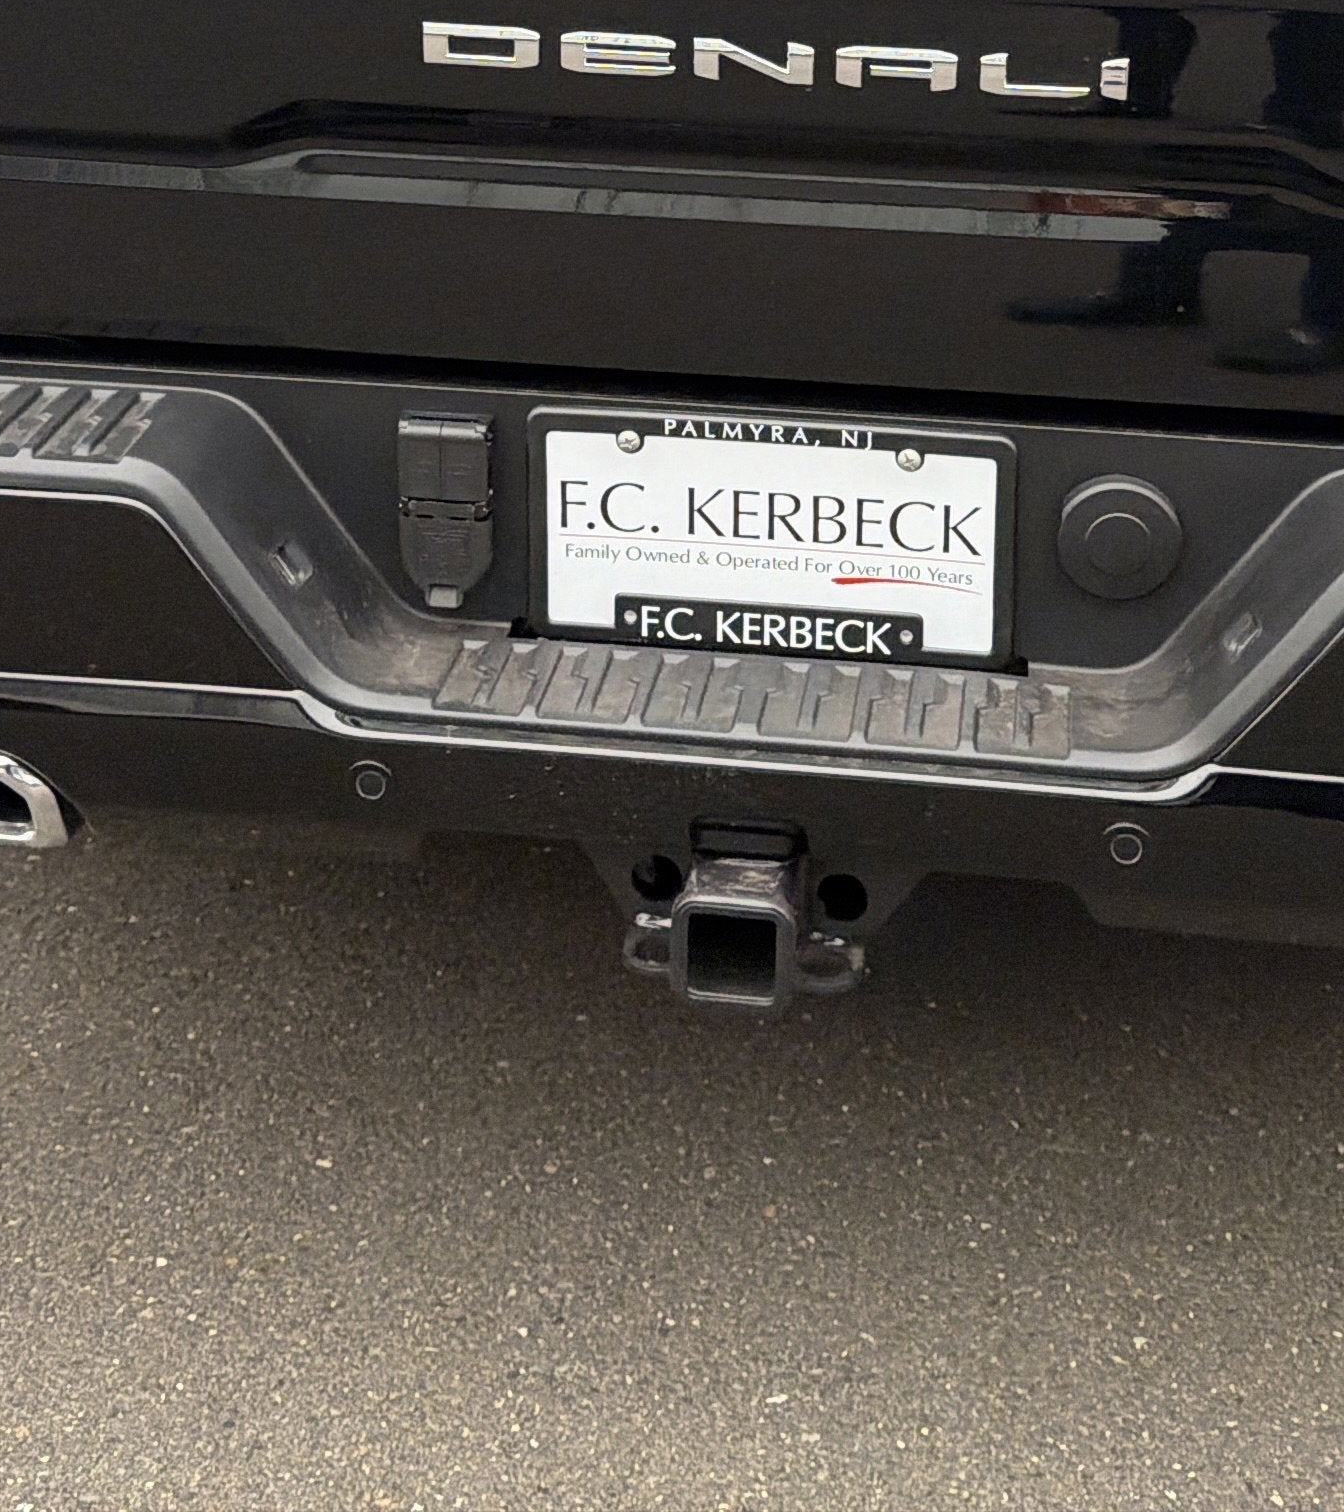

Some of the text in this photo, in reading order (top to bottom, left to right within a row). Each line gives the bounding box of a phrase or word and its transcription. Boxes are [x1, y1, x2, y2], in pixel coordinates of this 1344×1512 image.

[422, 21, 1131, 101] DENALI
[663, 418, 874, 450] PALMYRA, NJ
[559, 479, 982, 557] F.C. KERBECK
[564, 543, 974, 585] Family Owned & Operated For Over 100 Years
[639, 605, 892, 656] F.C. KERBECK
